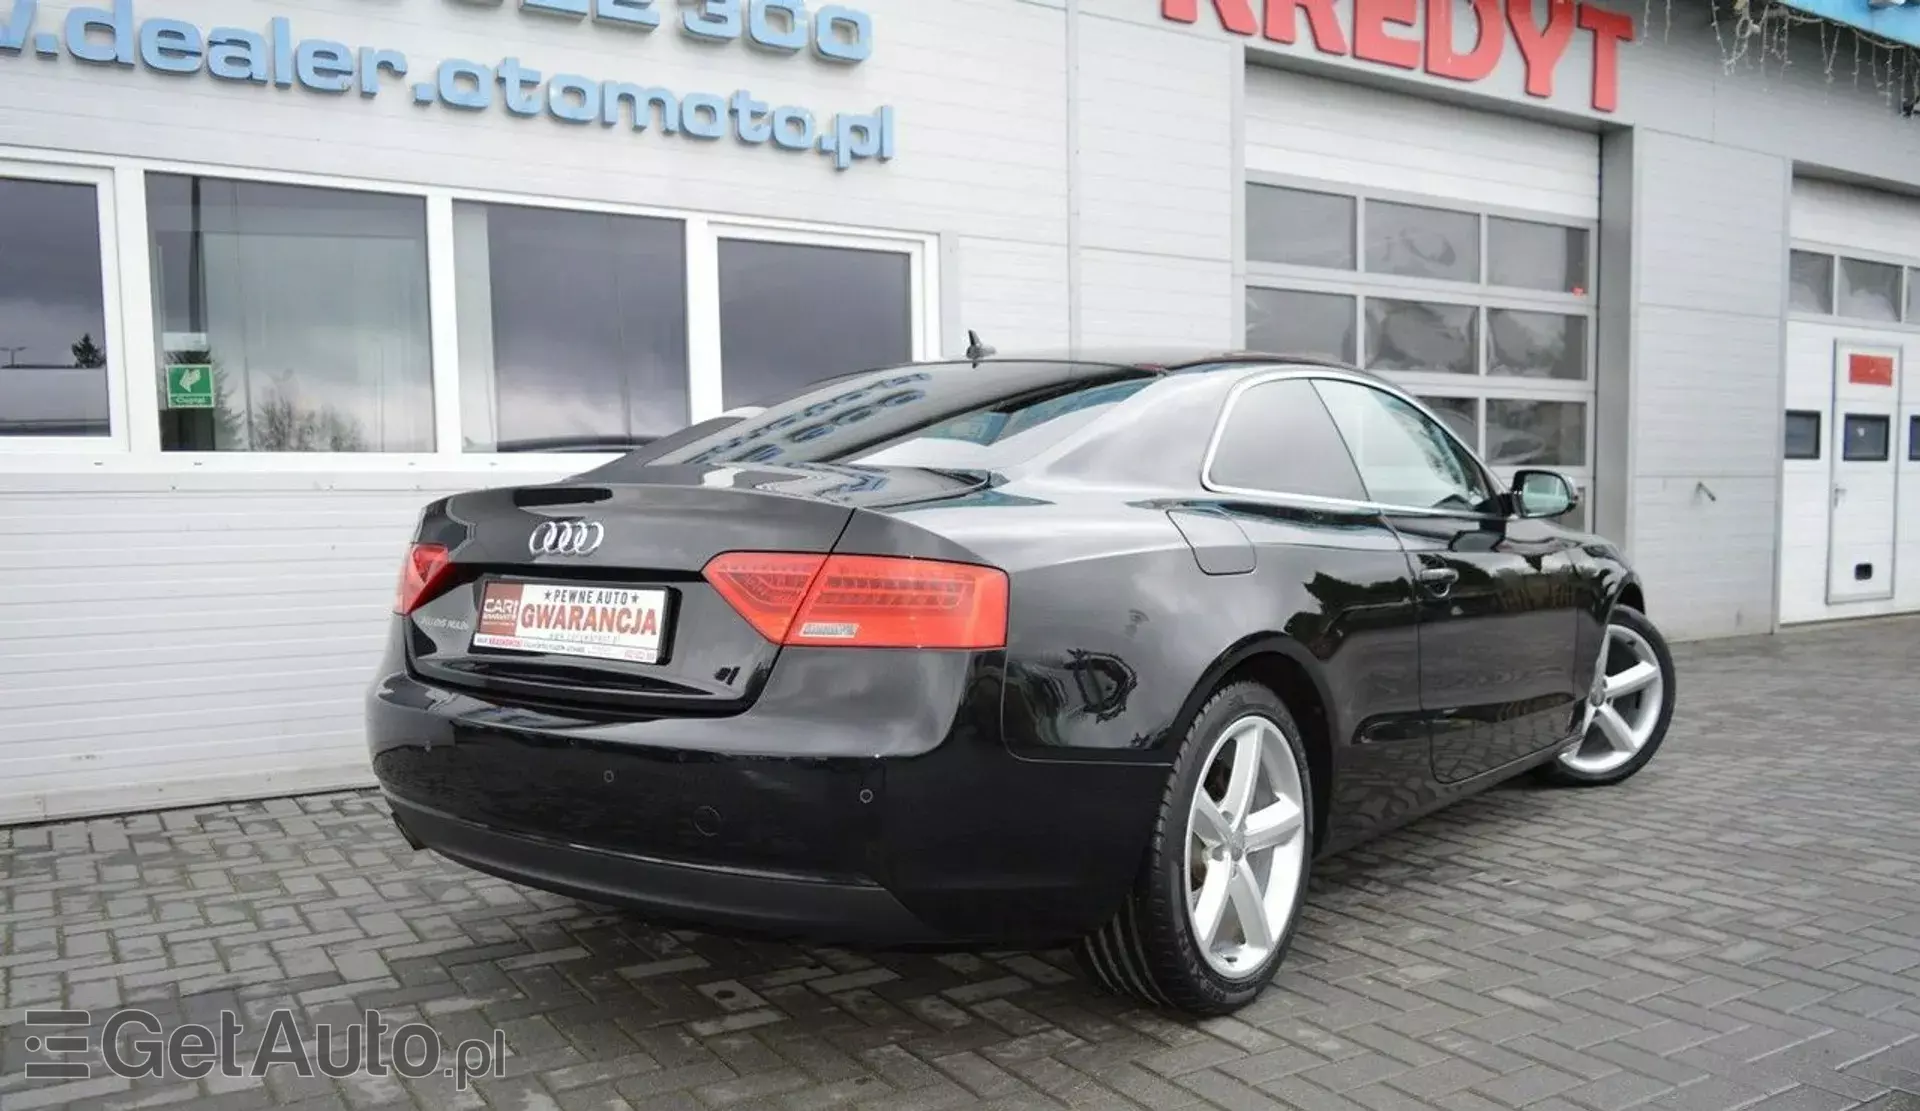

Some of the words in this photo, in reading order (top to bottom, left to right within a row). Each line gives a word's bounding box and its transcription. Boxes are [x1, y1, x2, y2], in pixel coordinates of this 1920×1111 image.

[553, 589, 594, 605] PEWNE
[595, 591, 629, 606] AUTO
[520, 602, 658, 636] GWARANCJA
